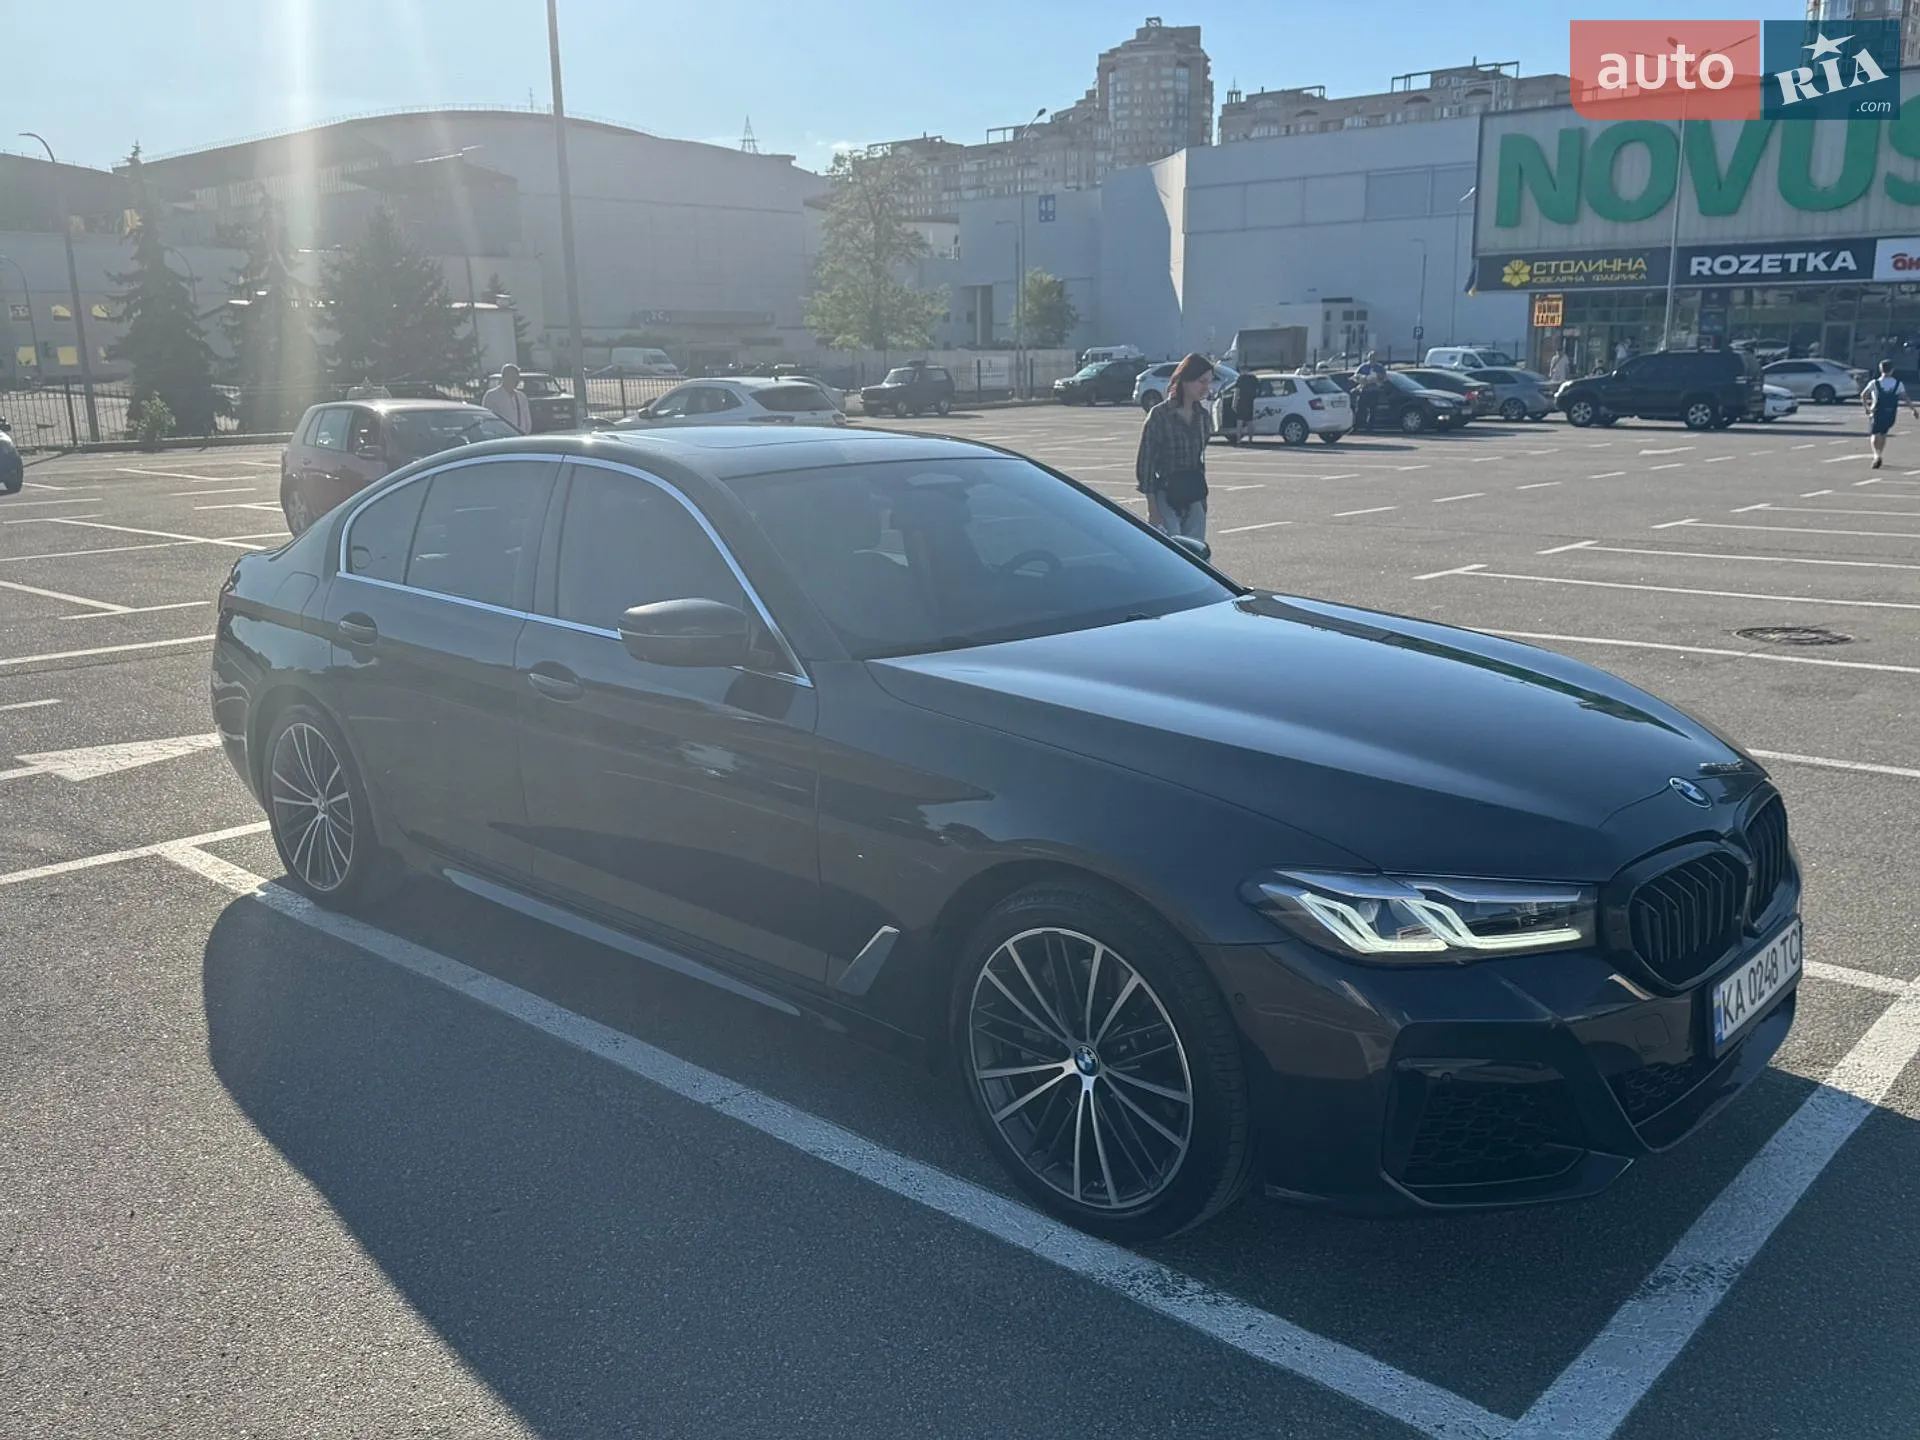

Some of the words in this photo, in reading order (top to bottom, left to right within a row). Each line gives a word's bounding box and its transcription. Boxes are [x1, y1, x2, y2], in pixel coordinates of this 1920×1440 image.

[1533, 257, 1647, 275] СТОЛИЧНА
[1689, 250, 1857, 276] ROZETKA
[1722, 978, 1746, 1030] KA
[1748, 947, 1779, 1006] 0248
[1780, 928, 1799, 974] TC
